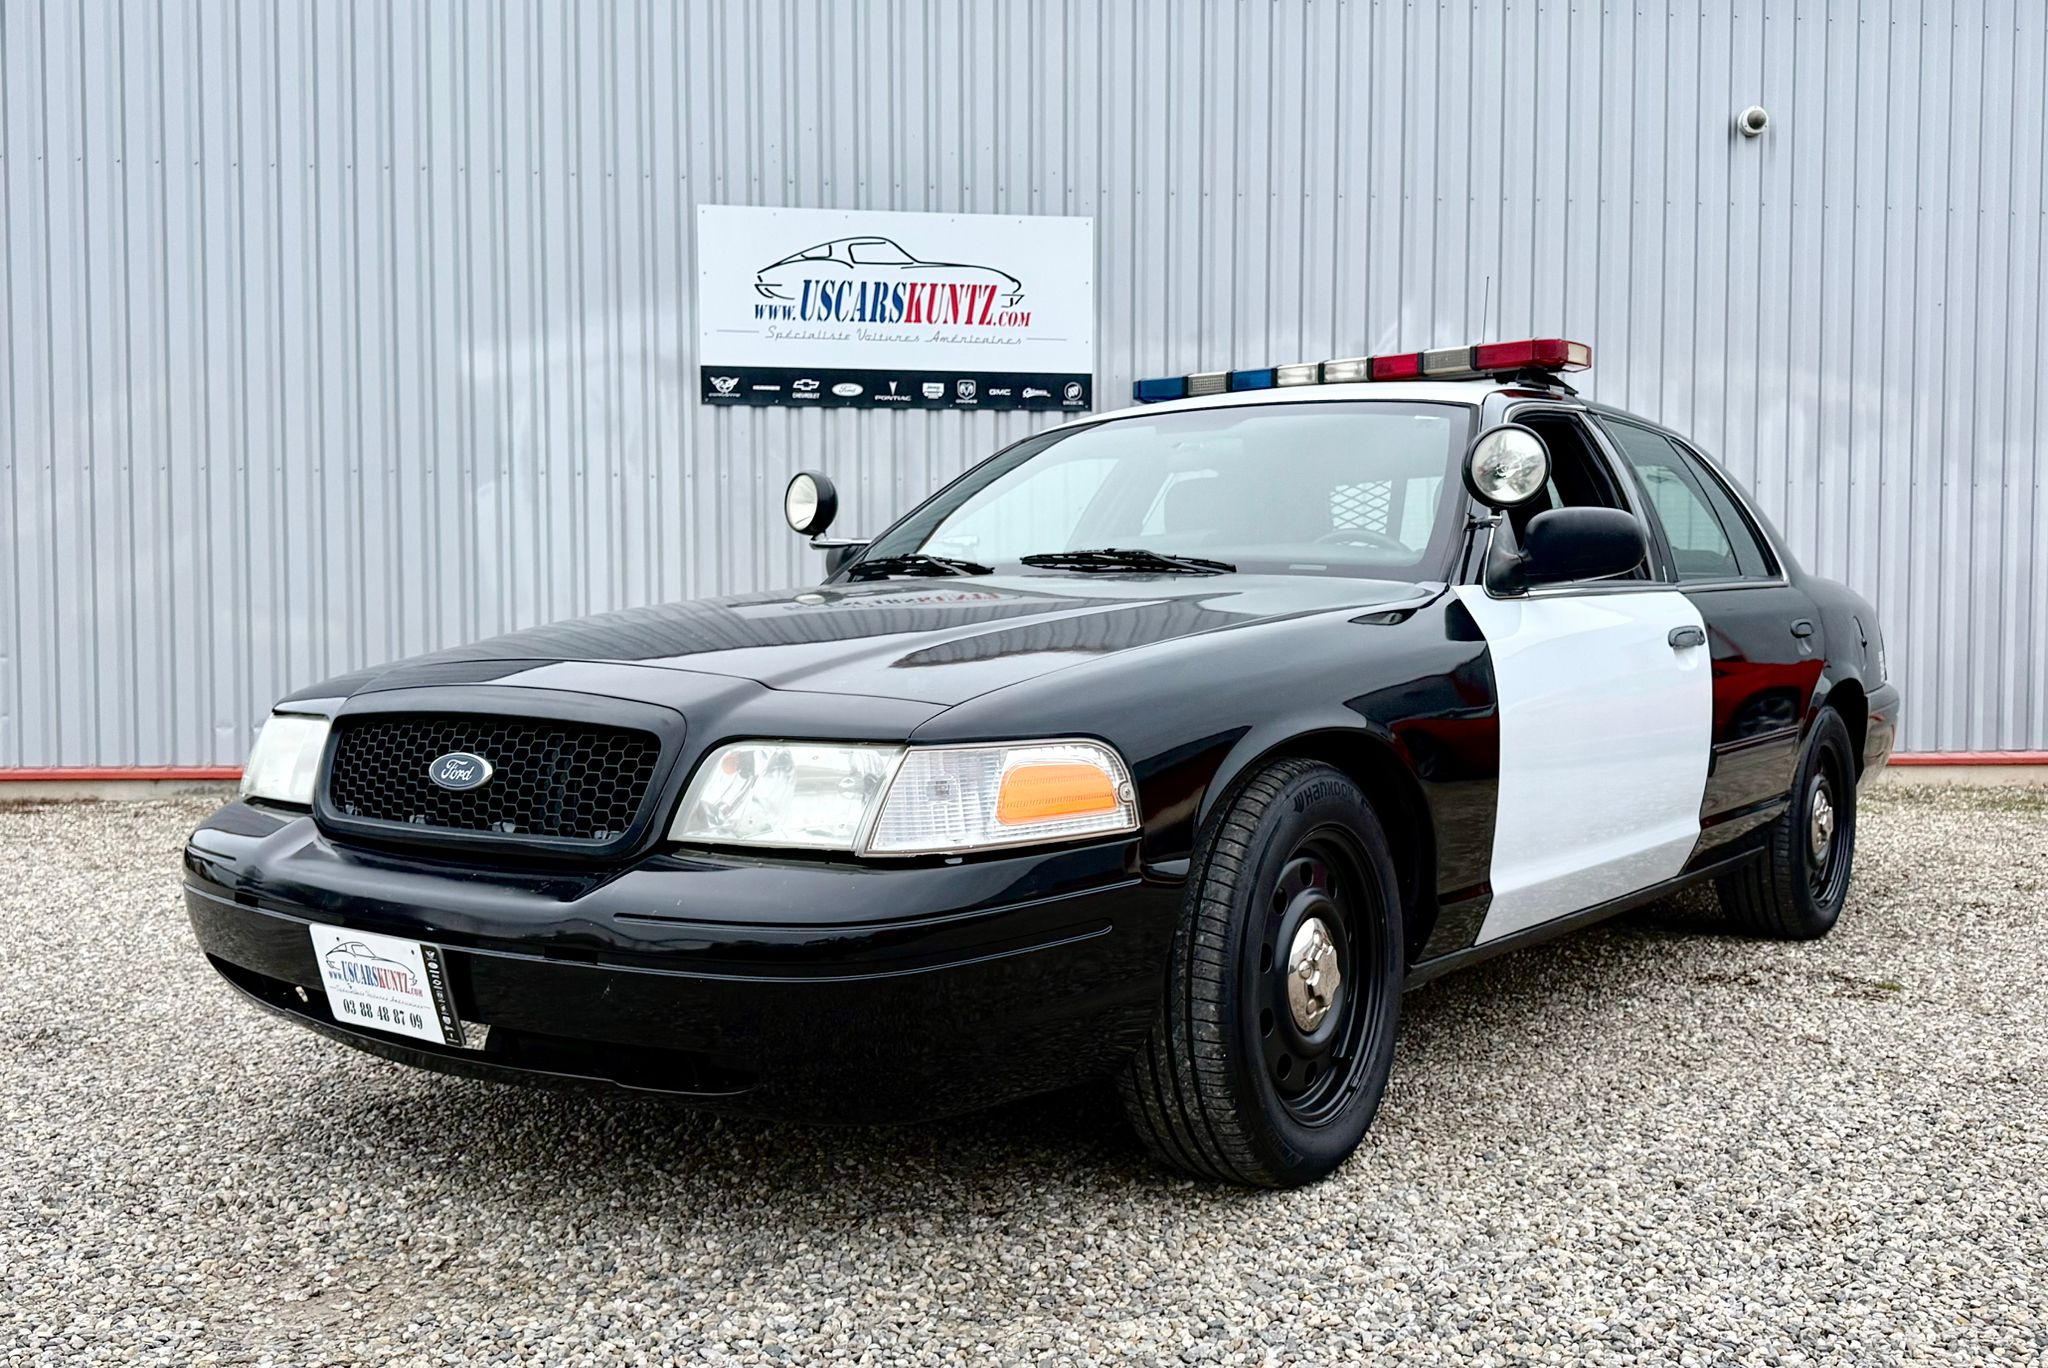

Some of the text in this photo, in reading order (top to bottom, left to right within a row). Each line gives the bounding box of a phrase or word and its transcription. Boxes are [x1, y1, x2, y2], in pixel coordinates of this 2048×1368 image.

[764, 325, 1023, 346] Spécialiste Voitures Américaines
[874, 394, 912, 402] PONTIAC
[988, 388, 1011, 396] GMC
[440, 758, 476, 781] Ford
[343, 998, 423, 1030] 03 88 48 87 09
